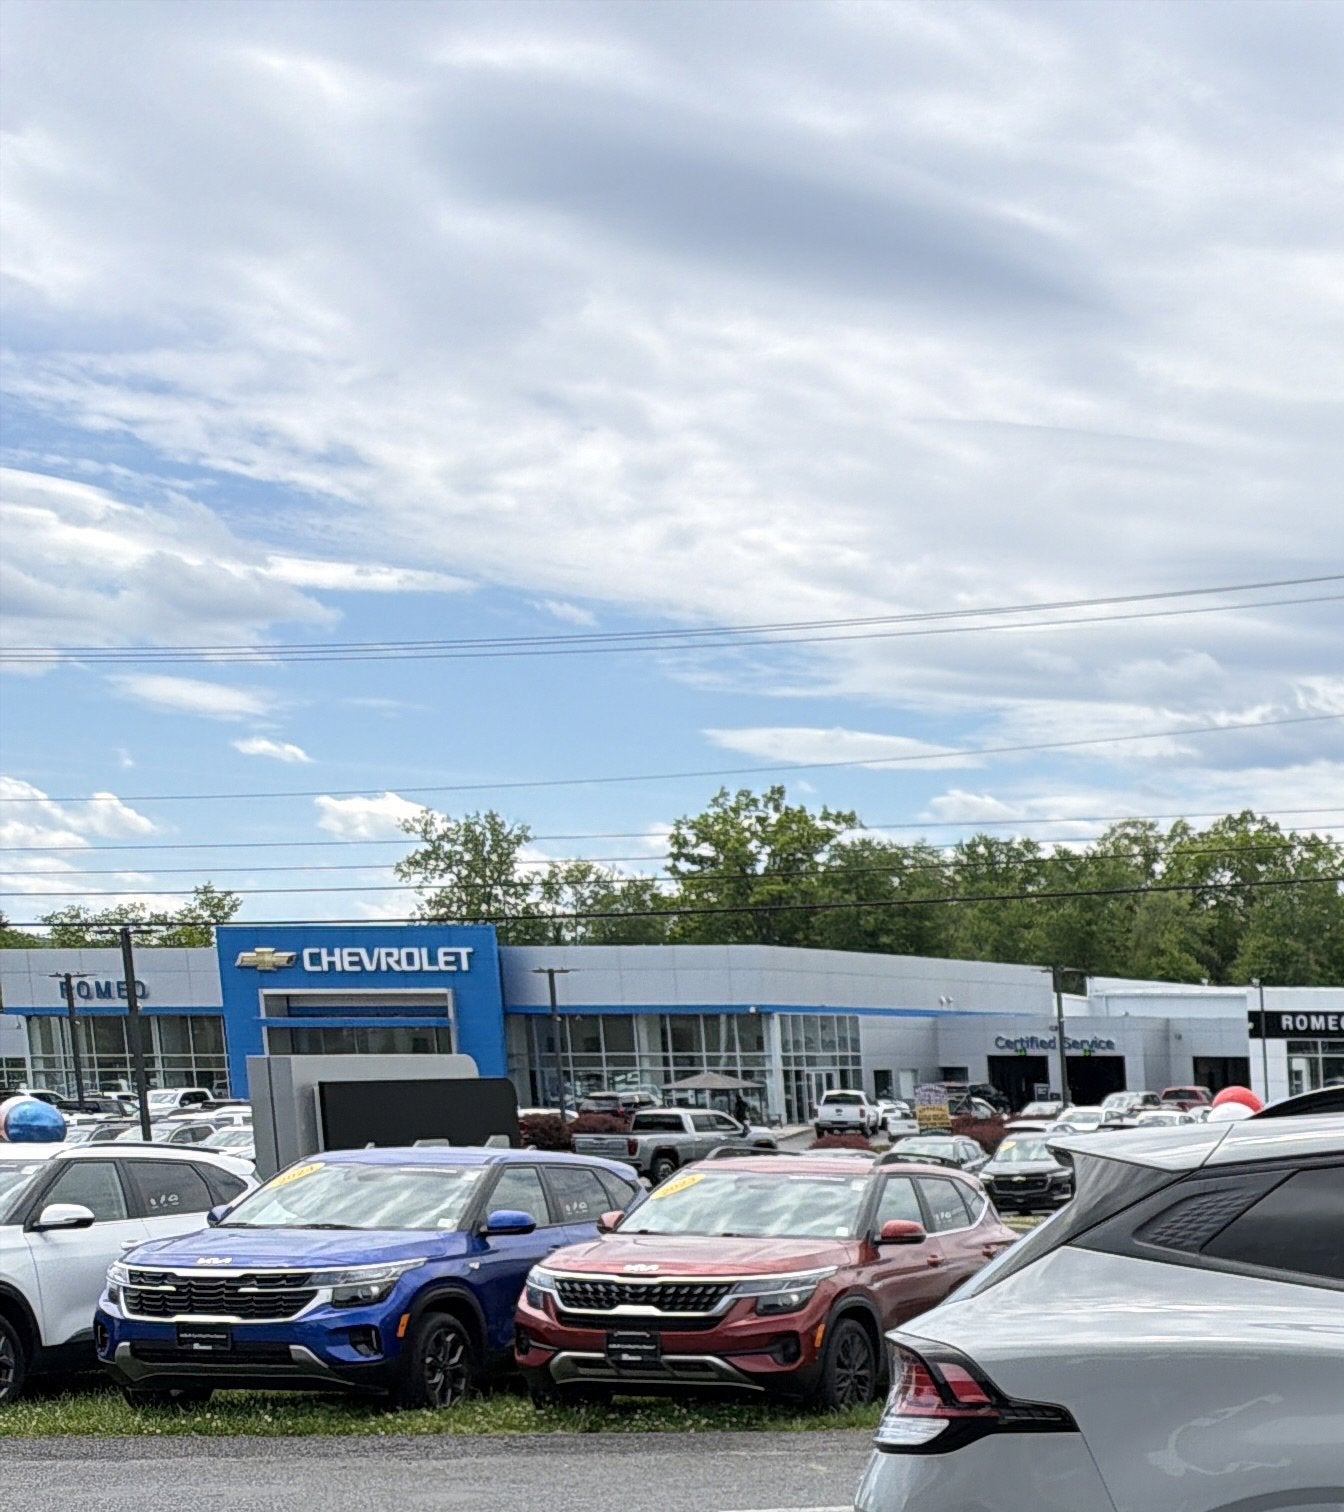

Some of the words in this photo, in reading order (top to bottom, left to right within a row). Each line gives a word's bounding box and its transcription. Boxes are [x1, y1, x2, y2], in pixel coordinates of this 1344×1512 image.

[303, 947, 474, 972] CHEVROLET
[995, 1036, 1057, 1050] Certified
[1061, 1036, 1116, 1051] Service
